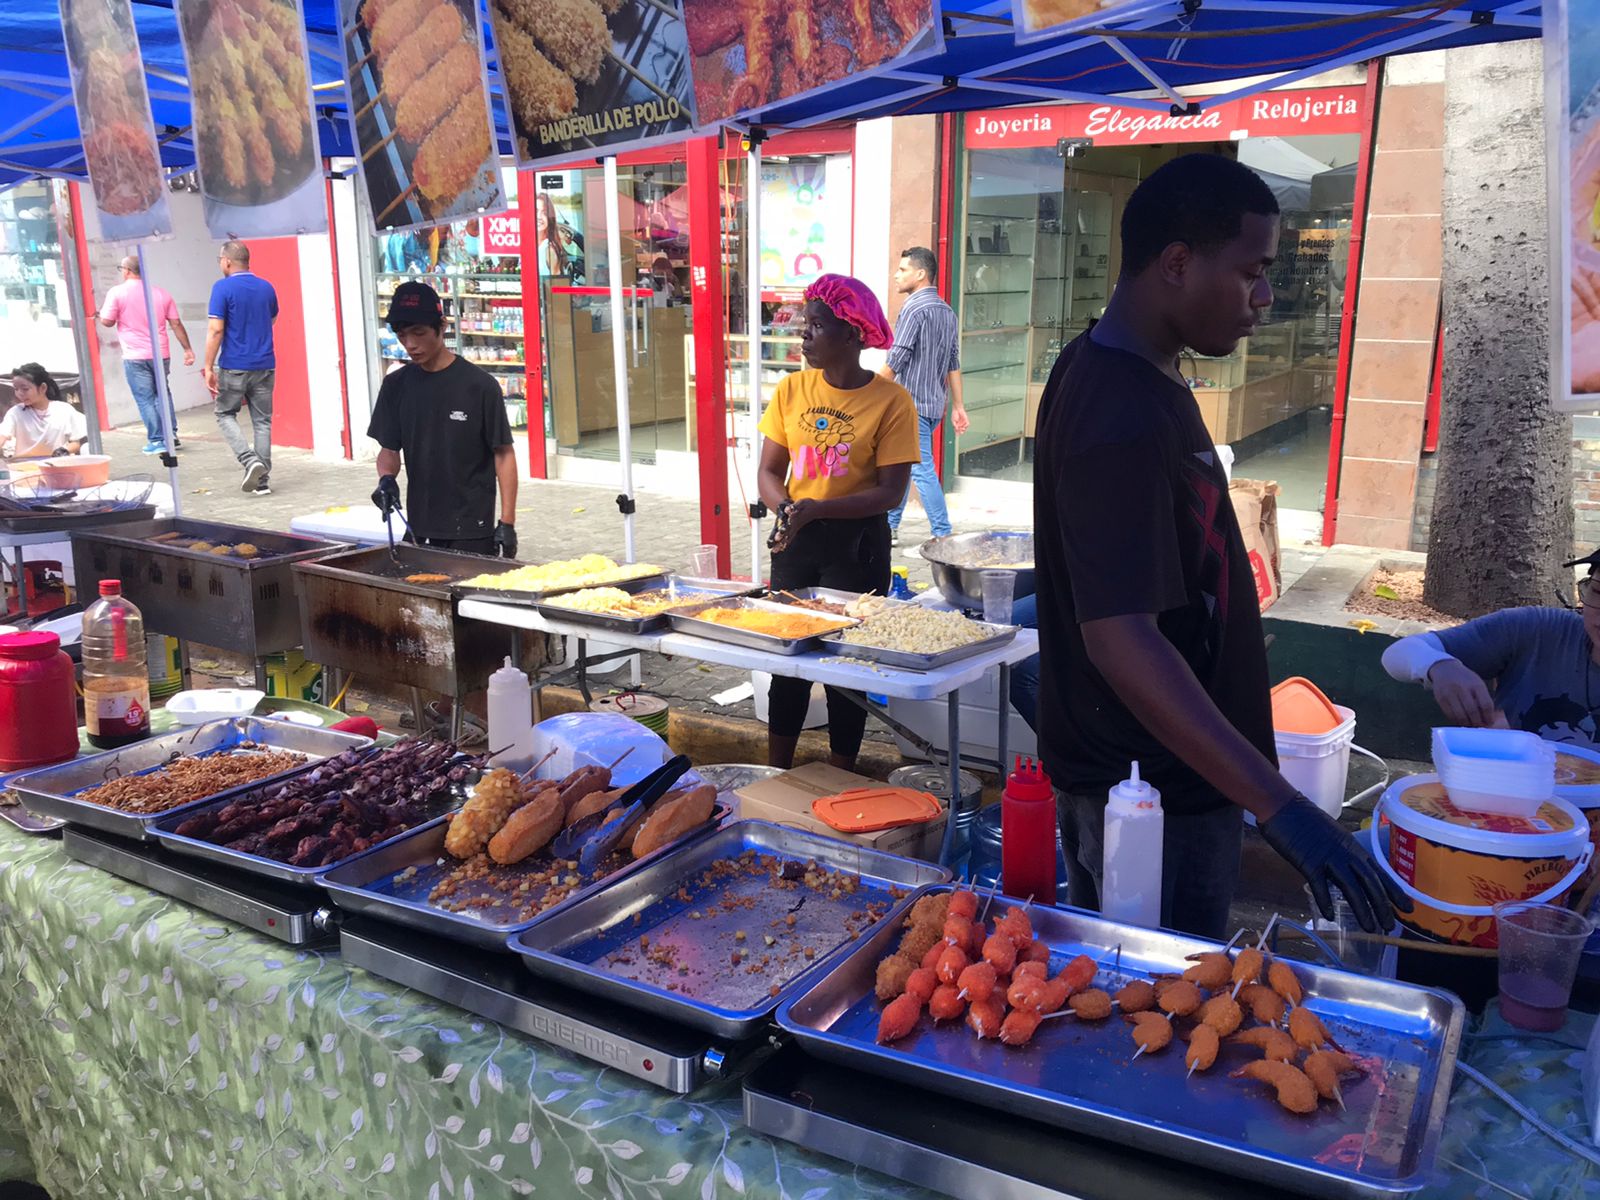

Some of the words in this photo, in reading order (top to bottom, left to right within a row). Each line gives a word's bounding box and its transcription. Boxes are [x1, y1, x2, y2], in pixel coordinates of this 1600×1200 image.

[539, 111, 614, 145] BANDERILLA
[614, 106, 634, 130] DE
[634, 96, 680, 126] POLLO
[975, 113, 1052, 138] Joyeria
[1084, 106, 1222, 140] Elegancia
[1251, 94, 1357, 122] Relojeria
[532, 1014, 631, 1066] CHEFMAN
